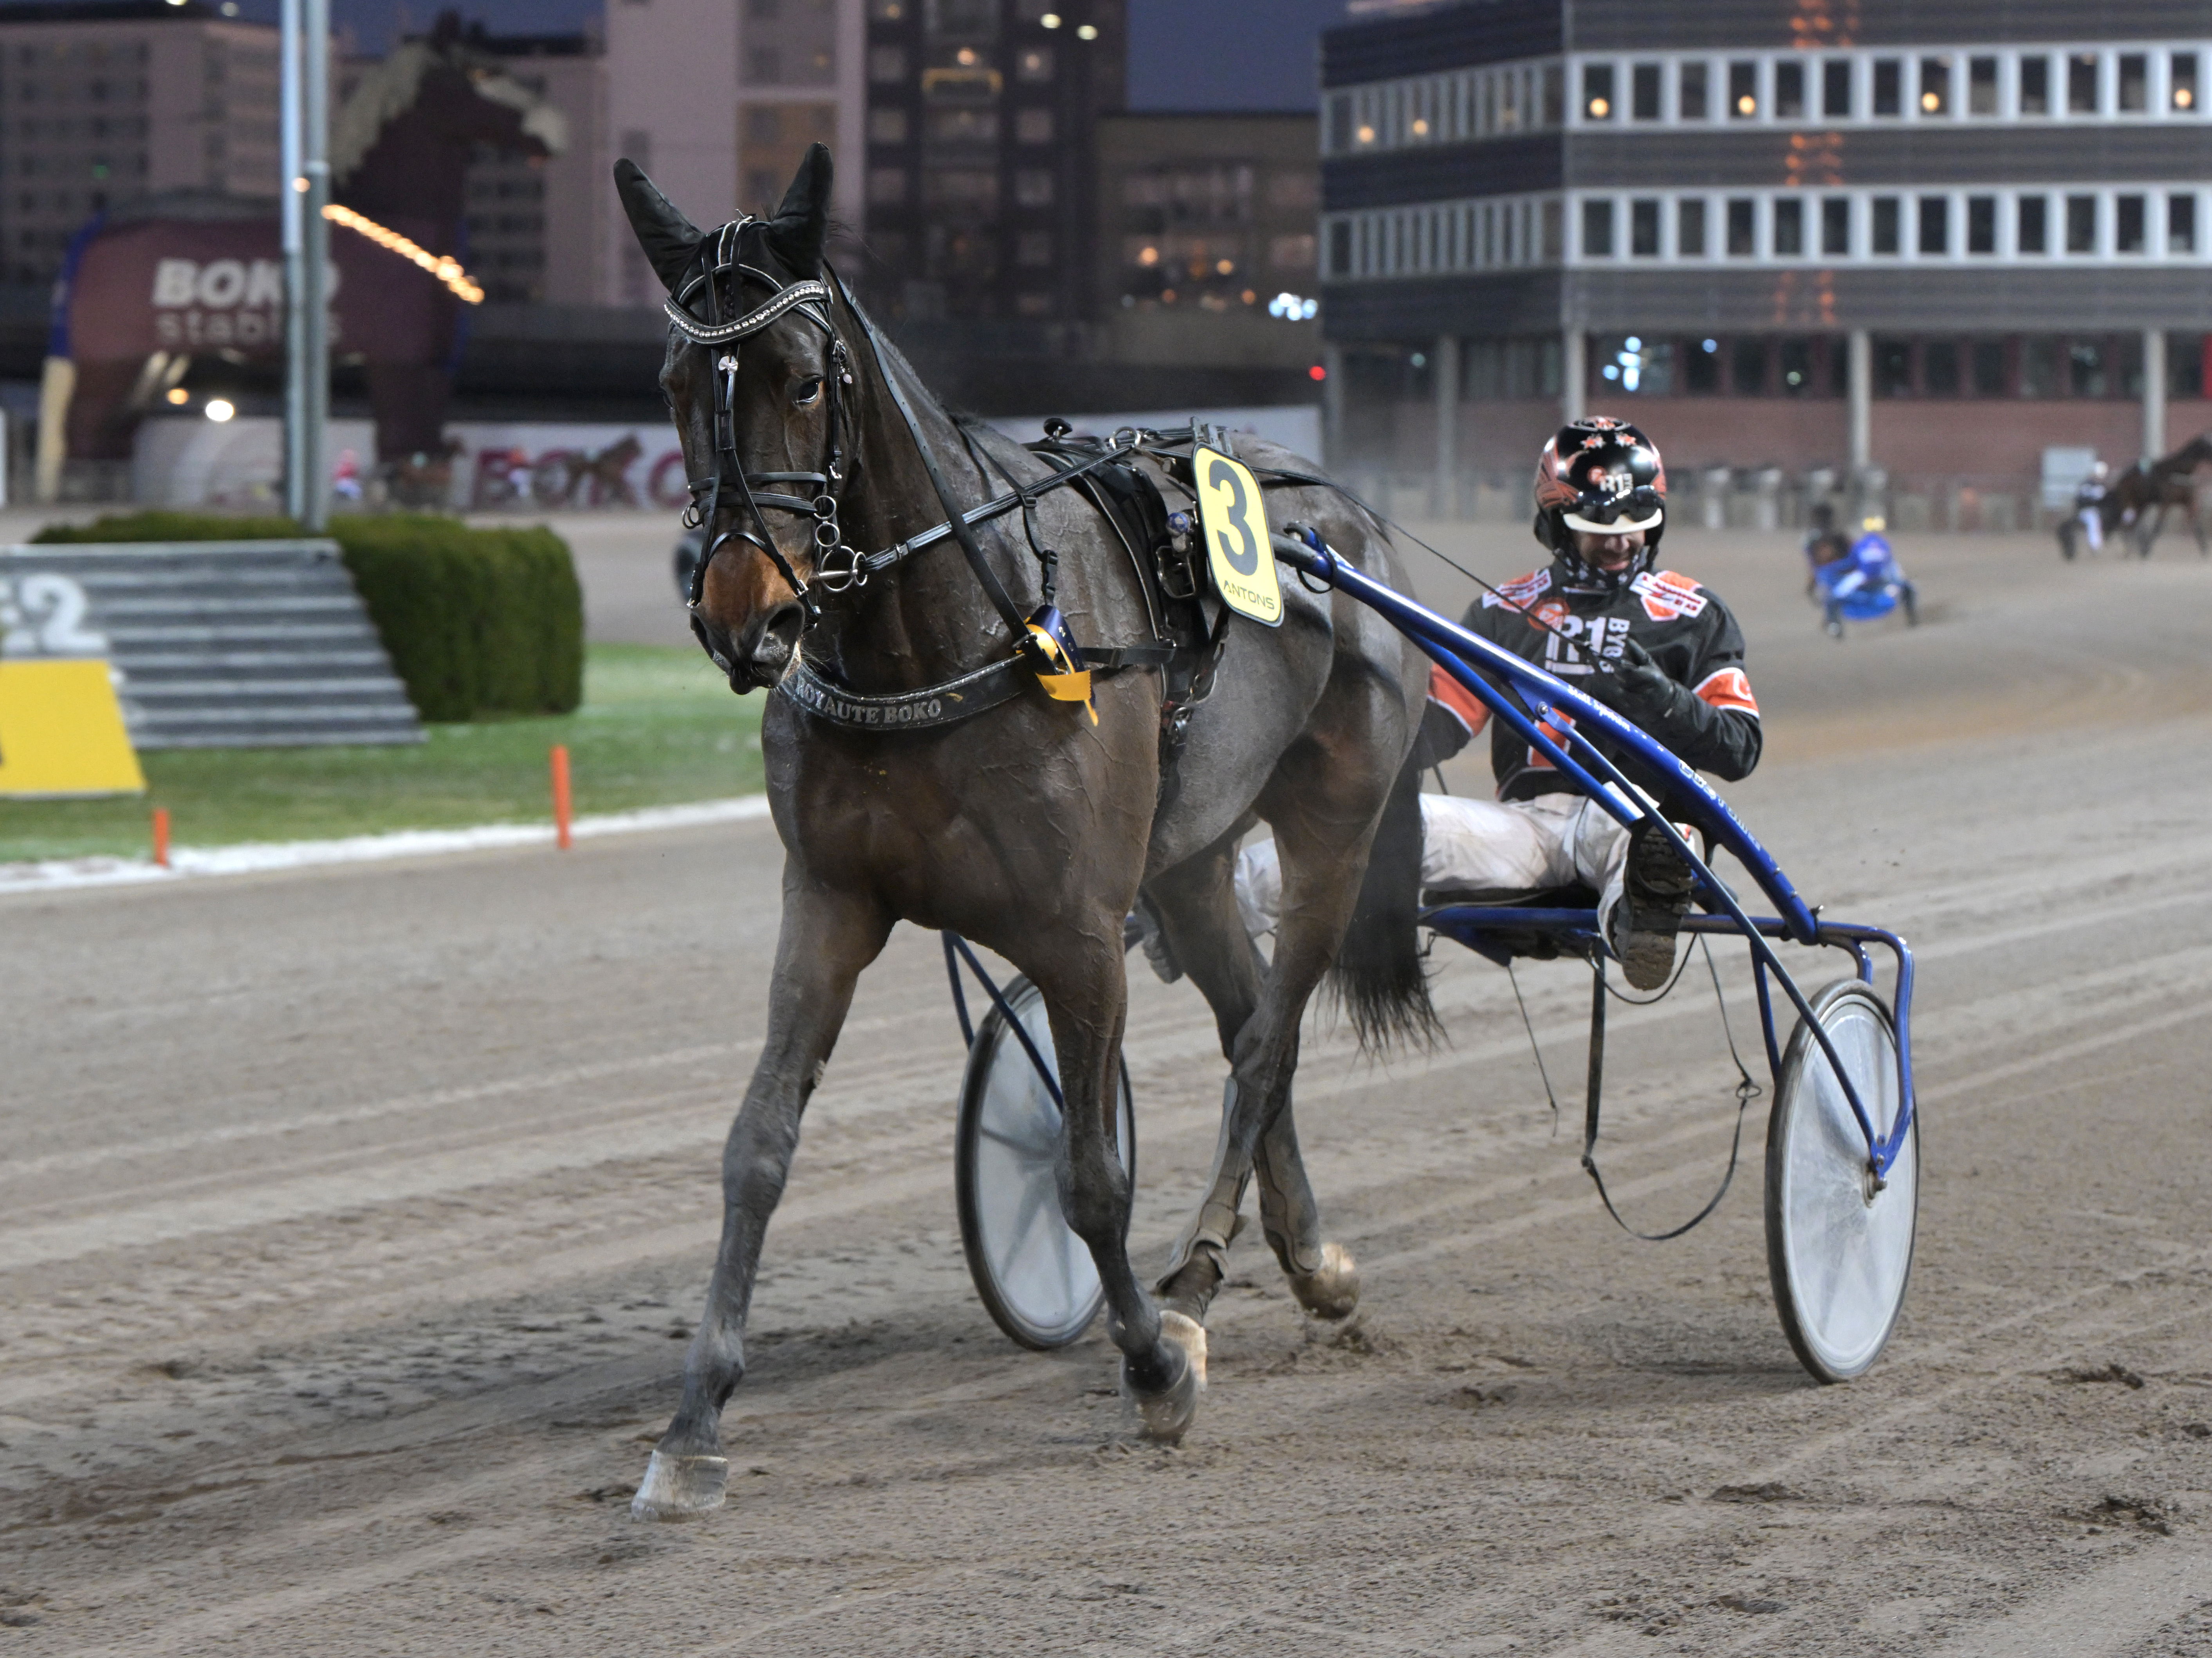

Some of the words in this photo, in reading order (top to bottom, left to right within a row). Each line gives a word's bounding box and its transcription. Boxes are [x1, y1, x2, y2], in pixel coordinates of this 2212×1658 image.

[153, 258, 340, 307] BOK
[1209, 459, 1258, 576] 3
[1223, 580, 1275, 610] ANTONS
[883, 698, 941, 724] BOKO
